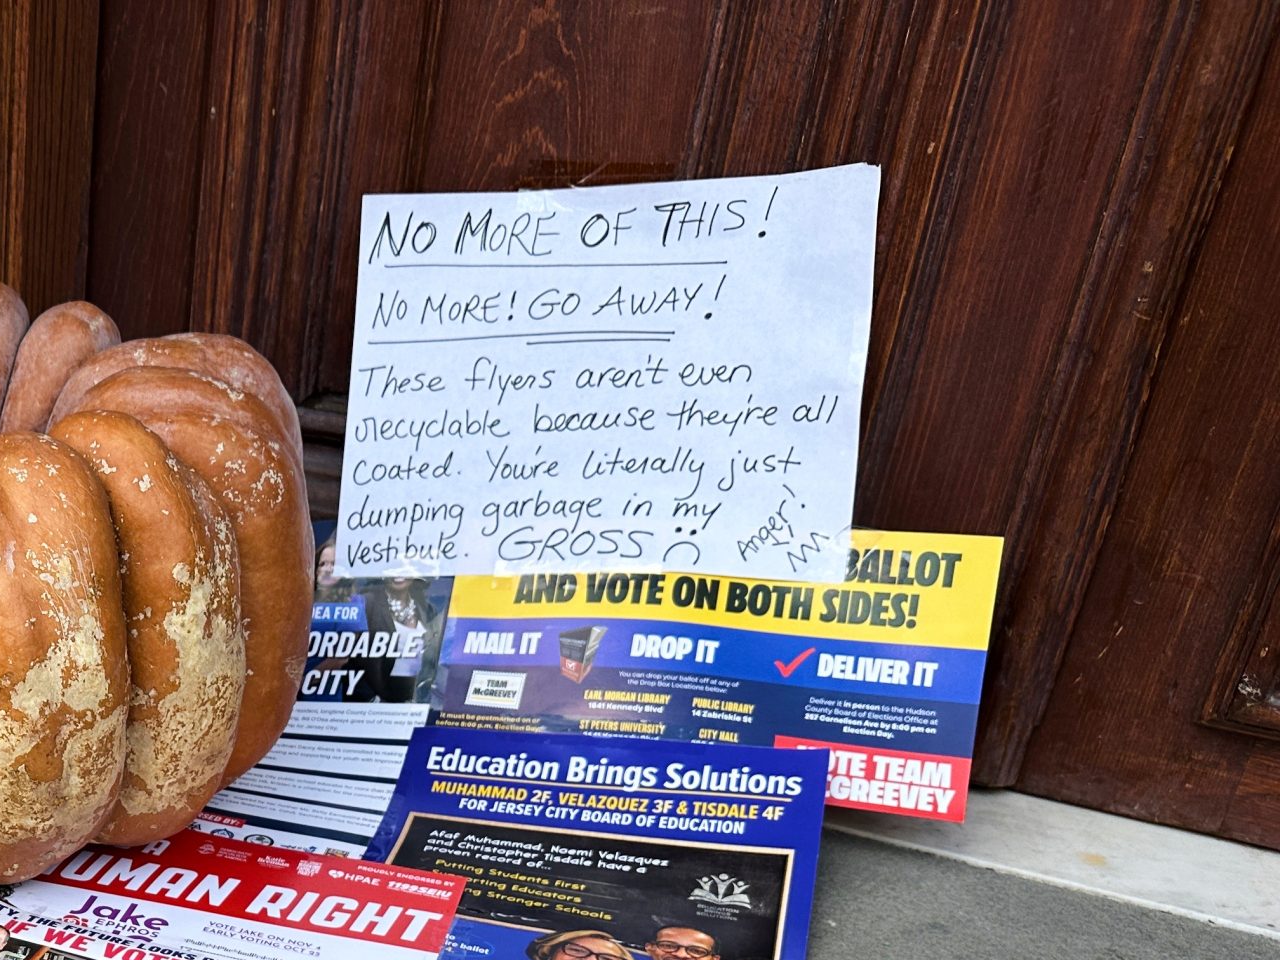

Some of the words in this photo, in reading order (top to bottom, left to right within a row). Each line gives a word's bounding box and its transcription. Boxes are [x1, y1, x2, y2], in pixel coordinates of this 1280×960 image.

[368, 212, 437, 264] NO
[455, 208, 560, 257] MORE
[581, 207, 636, 247] OF
[372, 290, 407, 329] NO
[421, 290, 516, 324] MORE!
[528, 289, 580, 320] GO
[592, 275, 726, 320] AWAY!
[358, 365, 445, 398] These
[465, 357, 555, 406] flyers
[576, 354, 668, 388] aren't
[679, 363, 752, 386] even
[355, 410, 510, 451] recyclable
[534, 403, 655, 433] because
[667, 394, 778, 436] they're
[793, 395, 838, 424] all
[486, 445, 559, 482] You're
[583, 447, 704, 501] literally
[718, 446, 801, 491] just
[348, 494, 464, 539] dumping
[482, 490, 602, 536] garbage
[623, 493, 652, 516] in
[673, 502, 721, 529] my
[498, 526, 654, 561] GROSS
[513, 573, 577, 604] AND
[585, 573, 666, 605] VOTE
[672, 575, 720, 611] ON
[725, 582, 814, 620] BOTH
[820, 589, 920, 629] SIDES!
[463, 631, 515, 654] MAIL
[520, 632, 542, 655] IT
[630, 634, 693, 661] DROP
[696, 640, 720, 664] IT
[301, 670, 365, 695] CITY
[487, 679, 507, 688] TEAM
[818, 653, 910, 686] DELIVER
[912, 662, 938, 688] IT
[472, 688, 517, 698] McGREEVEY
[427, 746, 559, 782] Education
[566, 756, 658, 792] Brings
[663, 763, 803, 796] Solutions
[431, 780, 528, 801] MUHAMMAD
[530, 790, 553, 805] 2F,
[559, 792, 649, 813] VELAZQUEZ
[652, 799, 673, 814] 3F
[676, 802, 688, 815] &
[693, 802, 758, 819] TISDALE
[762, 806, 785, 820] 4F
[345, 873, 380, 886] HPAE
[435, 858, 484, 876] Putting
[489, 868, 550, 885] Students
[70, 895, 169, 930] Jake
[95, 919, 161, 938] EPHROS
[246, 884, 443, 942] RIGHT
[43, 928, 96, 951] WE
